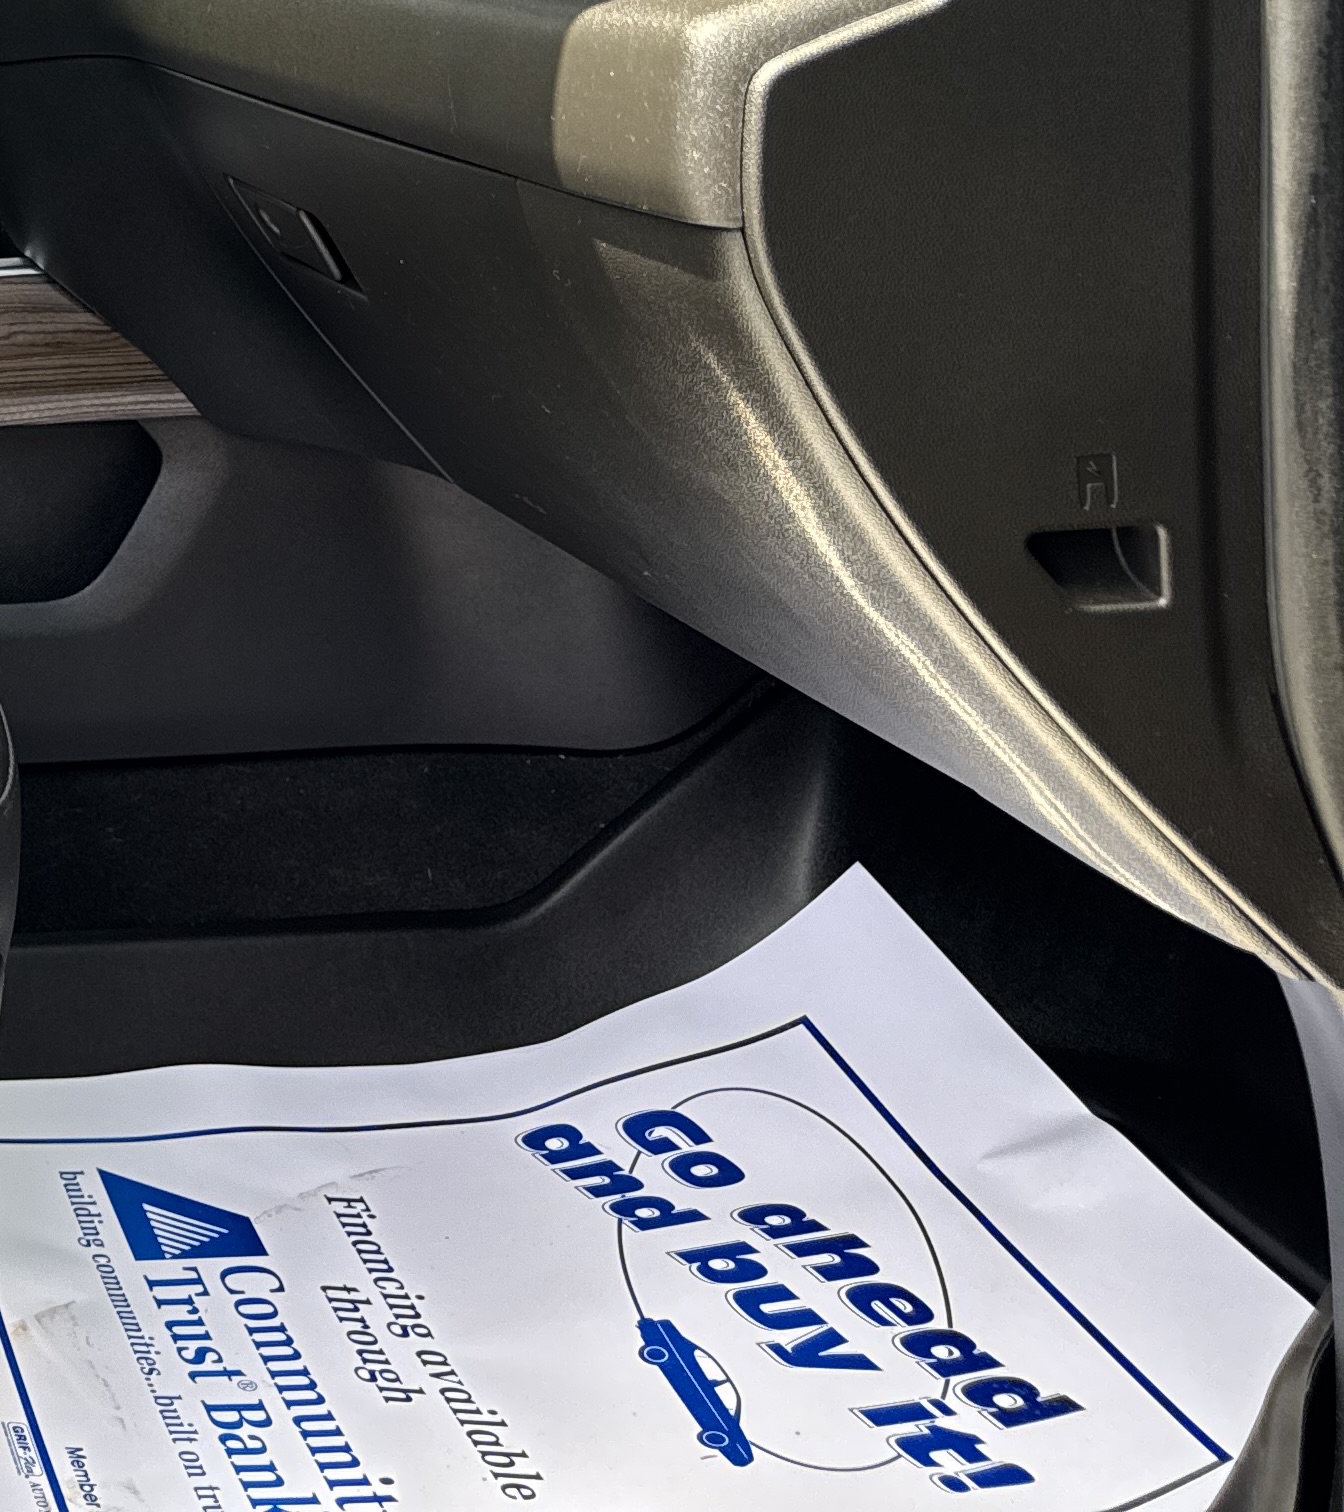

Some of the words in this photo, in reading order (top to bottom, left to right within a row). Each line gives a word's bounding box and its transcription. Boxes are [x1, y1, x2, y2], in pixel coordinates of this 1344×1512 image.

[58, 1170, 105, 1249] building
[178, 1450, 208, 1479] on
[219, 1264, 400, 1512] Communit
[319, 1283, 427, 1405] through
[323, 1193, 435, 1340] Financing
[415, 1349, 545, 1501] available
[514, 1122, 712, 1233] and
[665, 1240, 884, 1372] buy
[848, 1396, 1036, 1494] it!
[615, 1108, 746, 1189] Go
[730, 1202, 1087, 1430] ahead
[64, 1446, 102, 1509] Member
